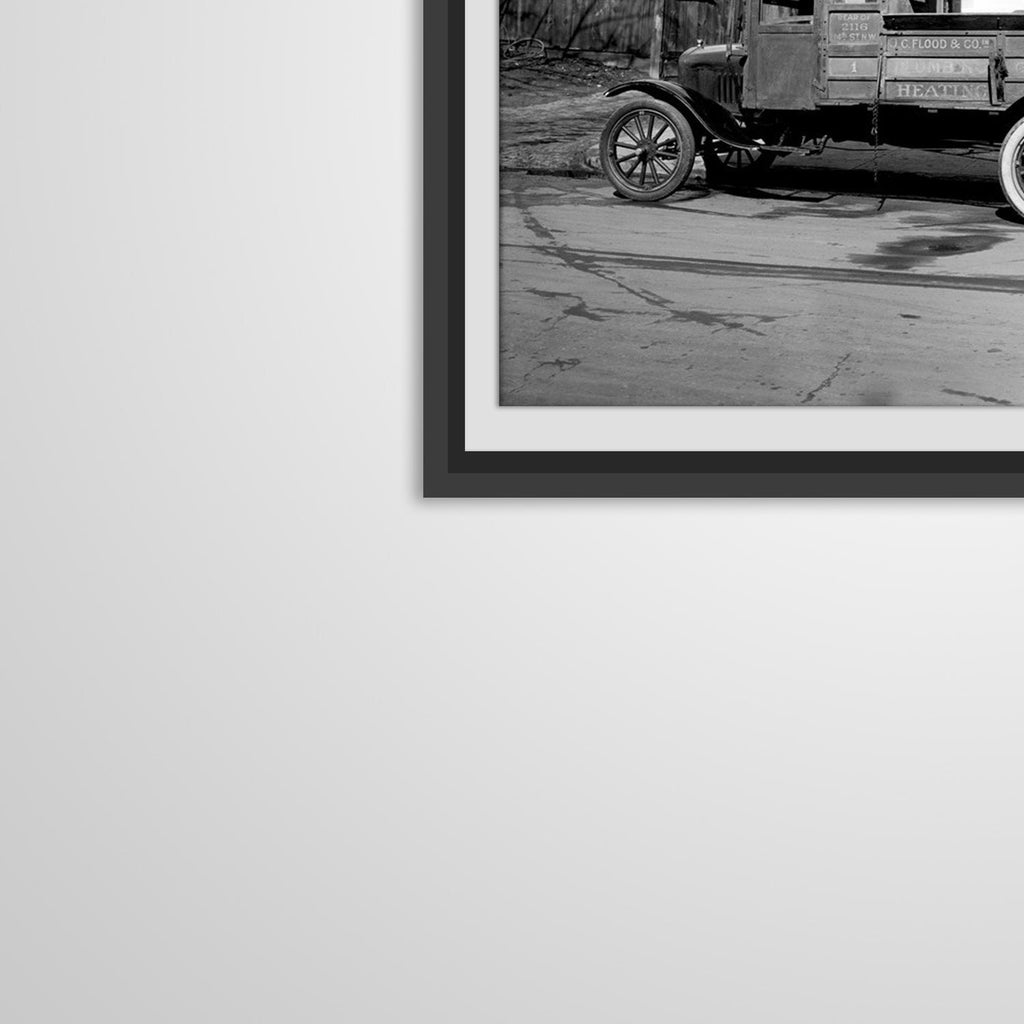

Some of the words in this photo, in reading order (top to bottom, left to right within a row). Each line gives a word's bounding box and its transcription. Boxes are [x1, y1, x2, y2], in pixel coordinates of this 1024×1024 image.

[841, 23, 868, 31] 2116
[911, 38, 947, 49] FLOOD
[950, 38, 961, 49] &
[850, 61, 857, 73] 1
[896, 84, 987, 97] HEATING
